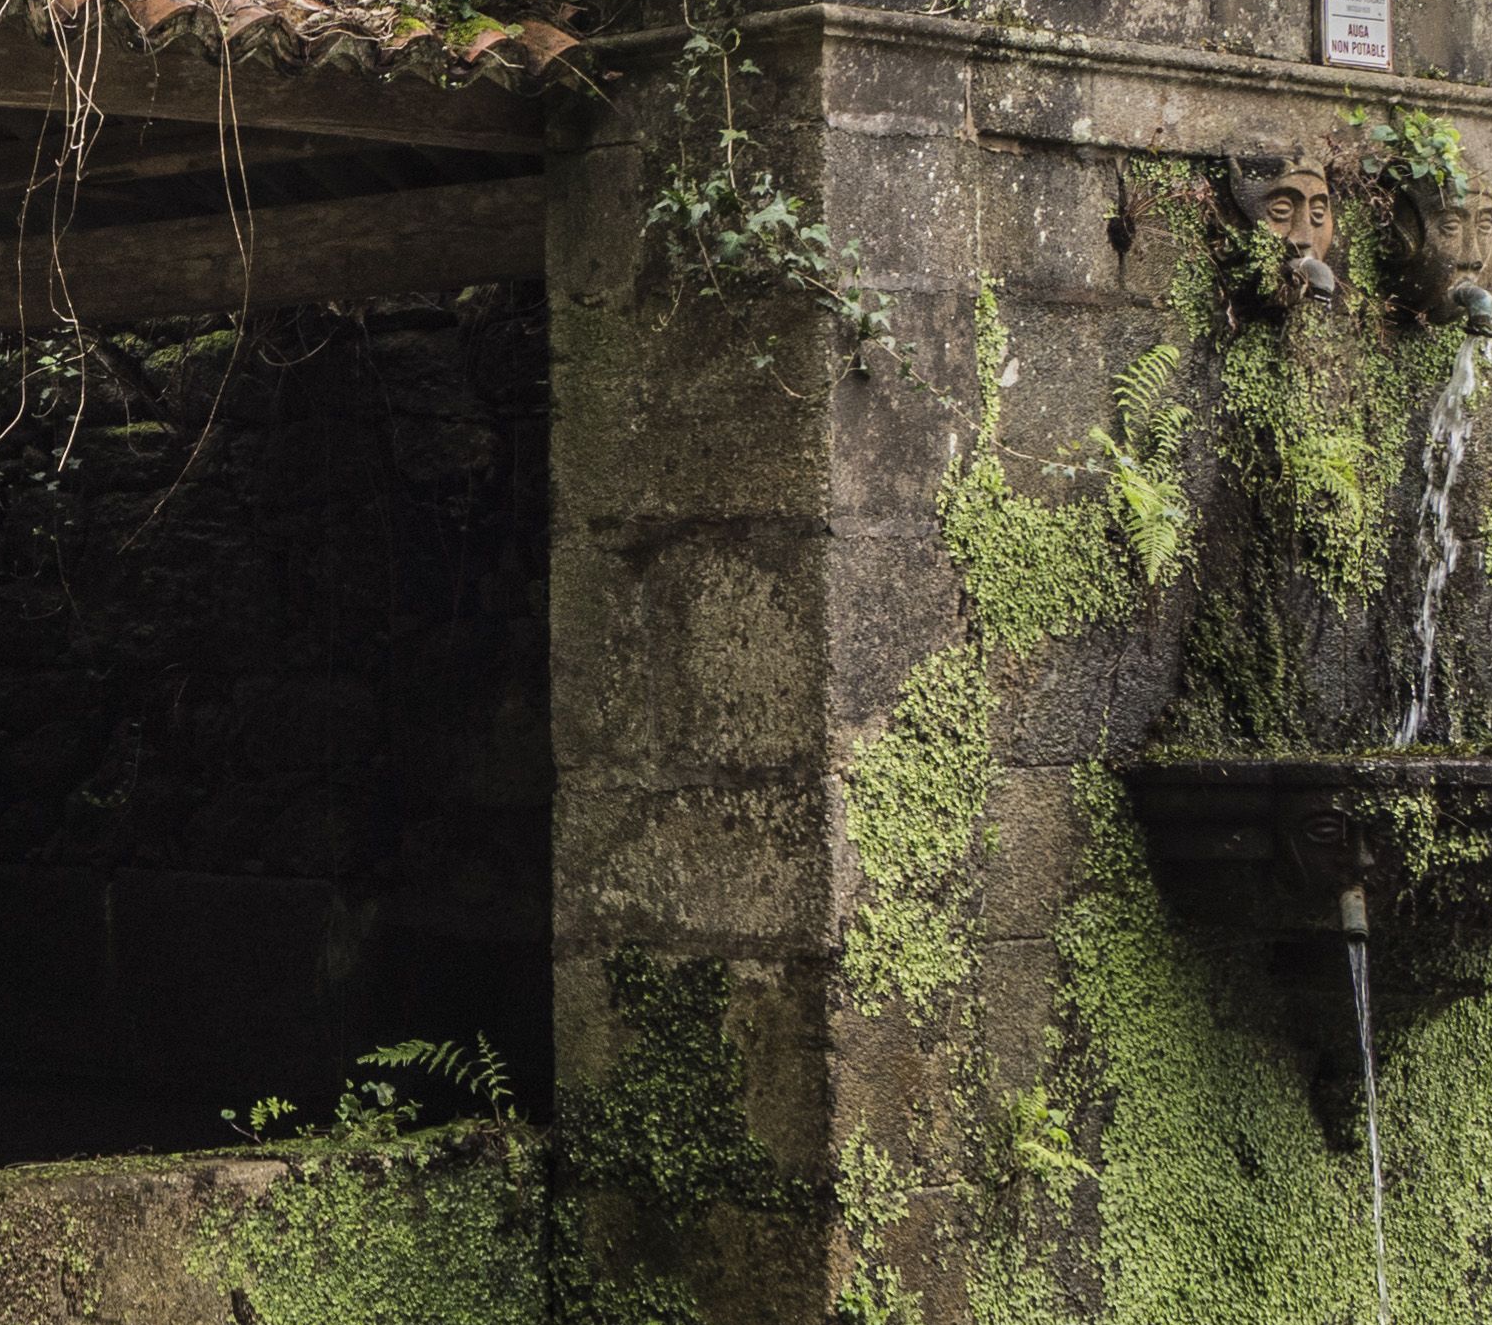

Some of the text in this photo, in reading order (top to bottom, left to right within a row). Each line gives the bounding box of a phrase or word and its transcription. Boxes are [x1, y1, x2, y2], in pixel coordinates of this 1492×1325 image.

[1348, 23, 1369, 38] AUGA
[1331, 39, 1386, 58] NON POTABLE
